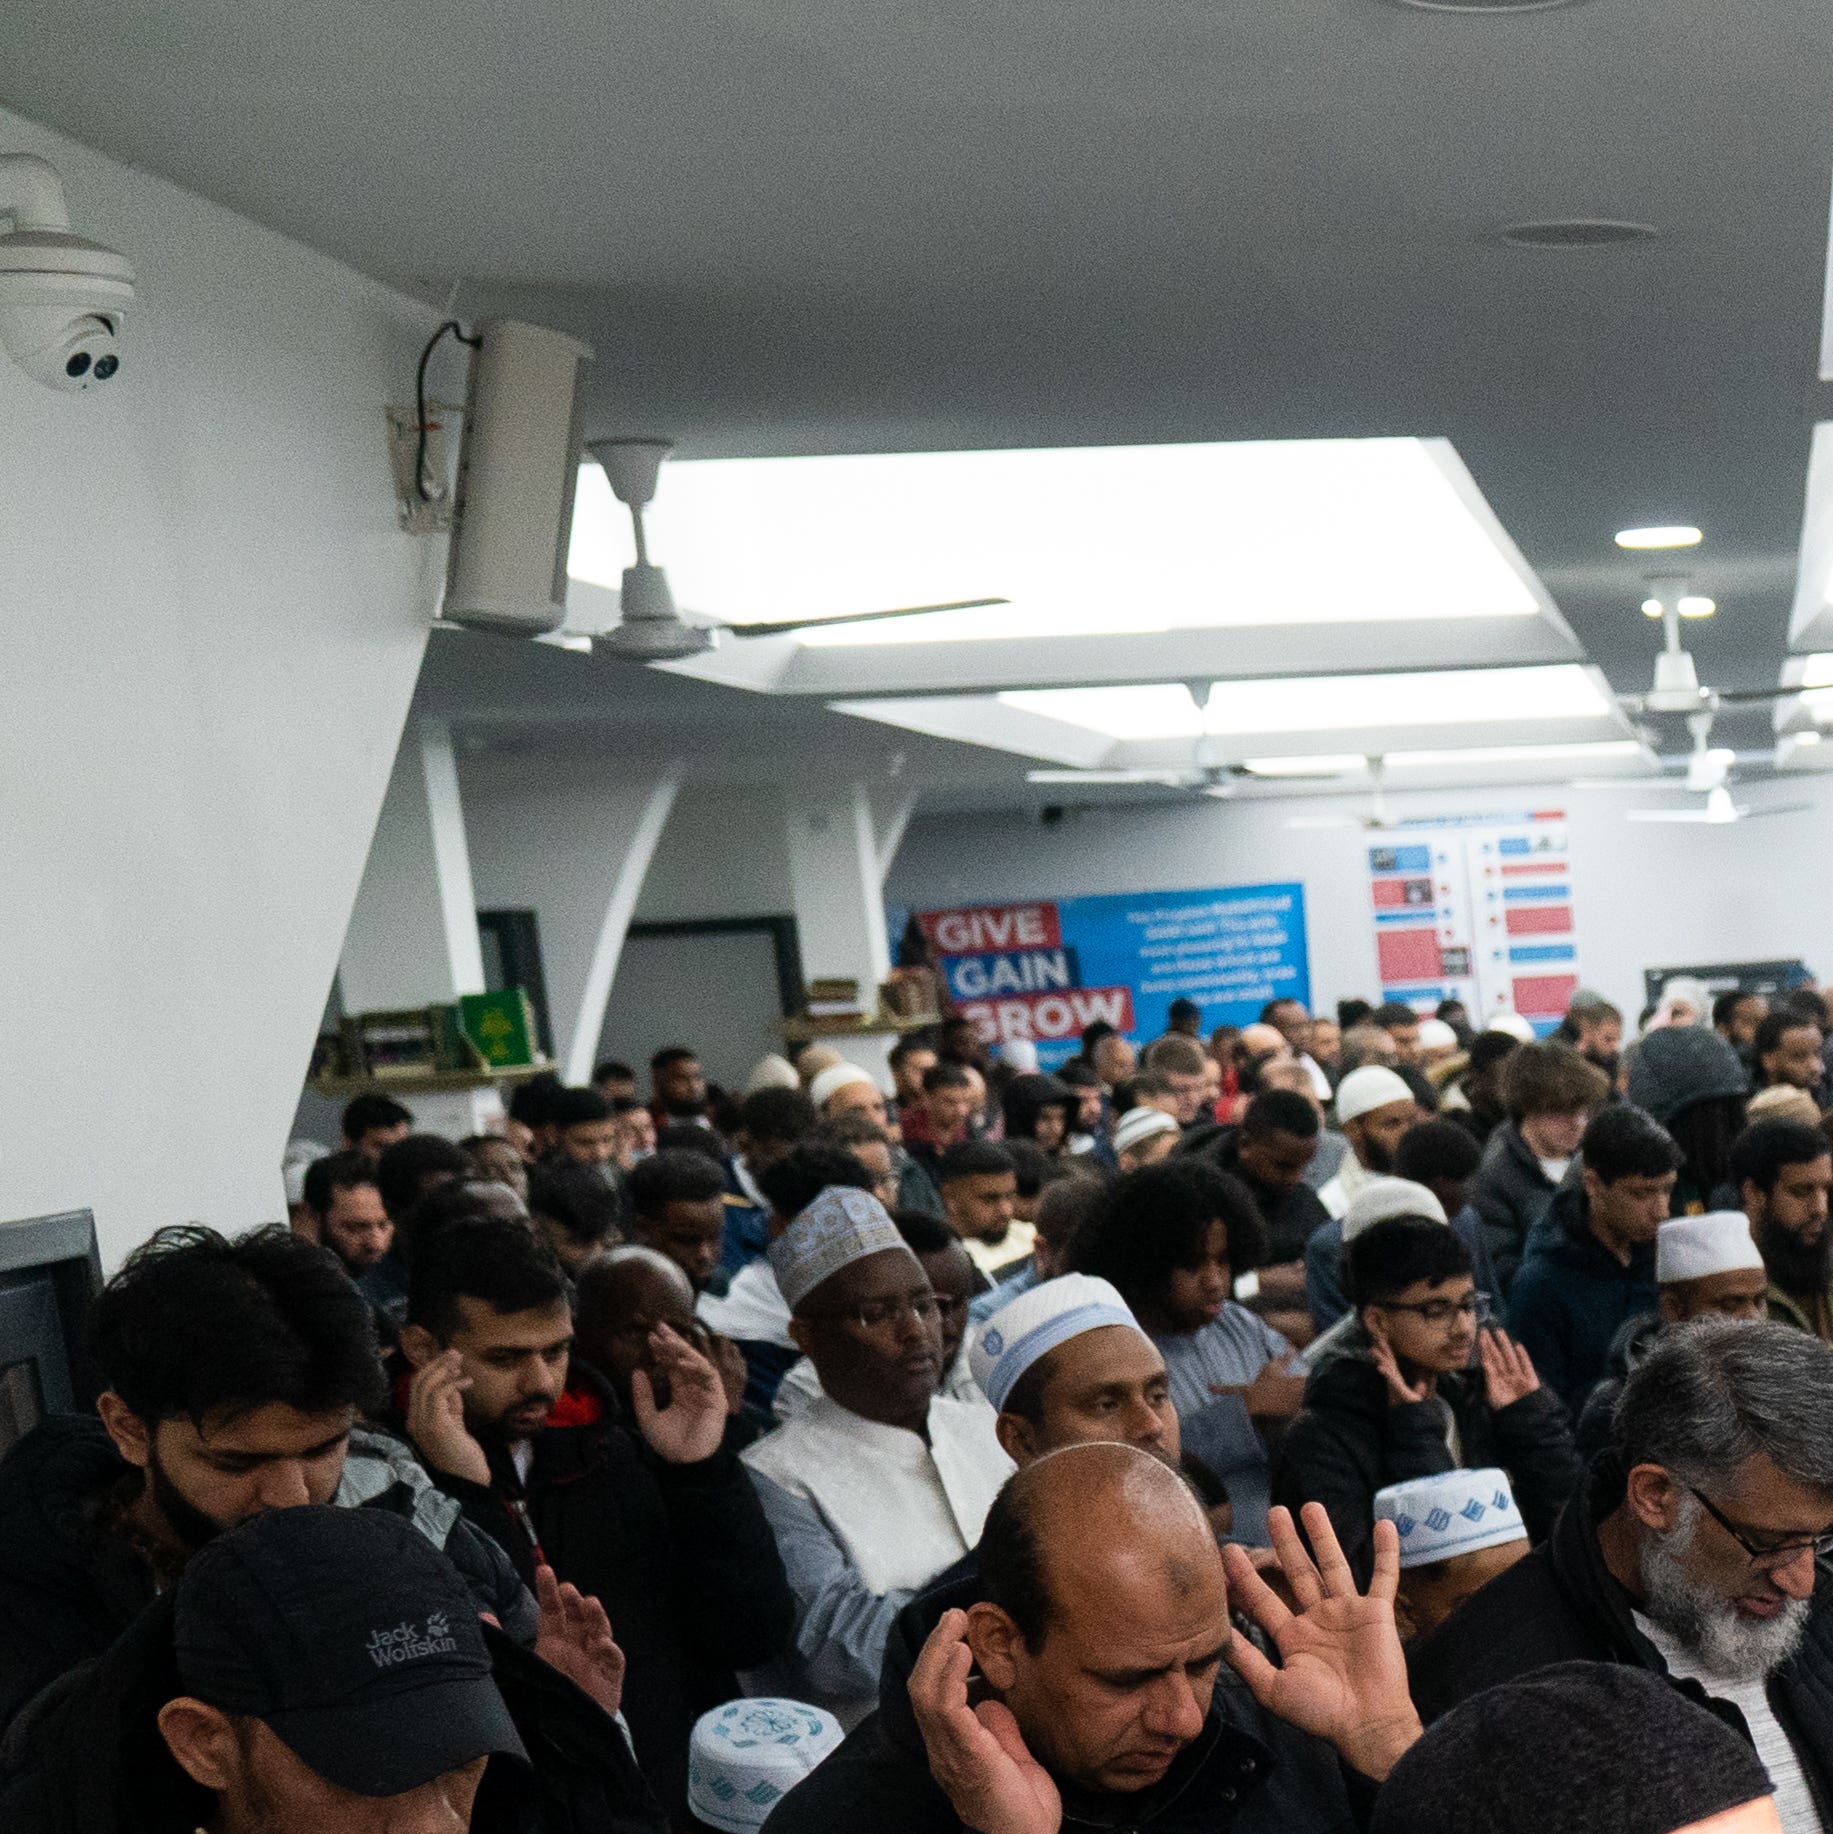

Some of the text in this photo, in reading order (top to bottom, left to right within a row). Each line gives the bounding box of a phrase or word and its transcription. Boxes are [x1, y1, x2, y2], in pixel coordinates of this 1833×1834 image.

[935, 907, 1047, 951] GIVE
[953, 951, 1070, 997] GAIN
[366, 1622, 420, 1649] Jack
[368, 1636, 457, 1668] Wolfskin
